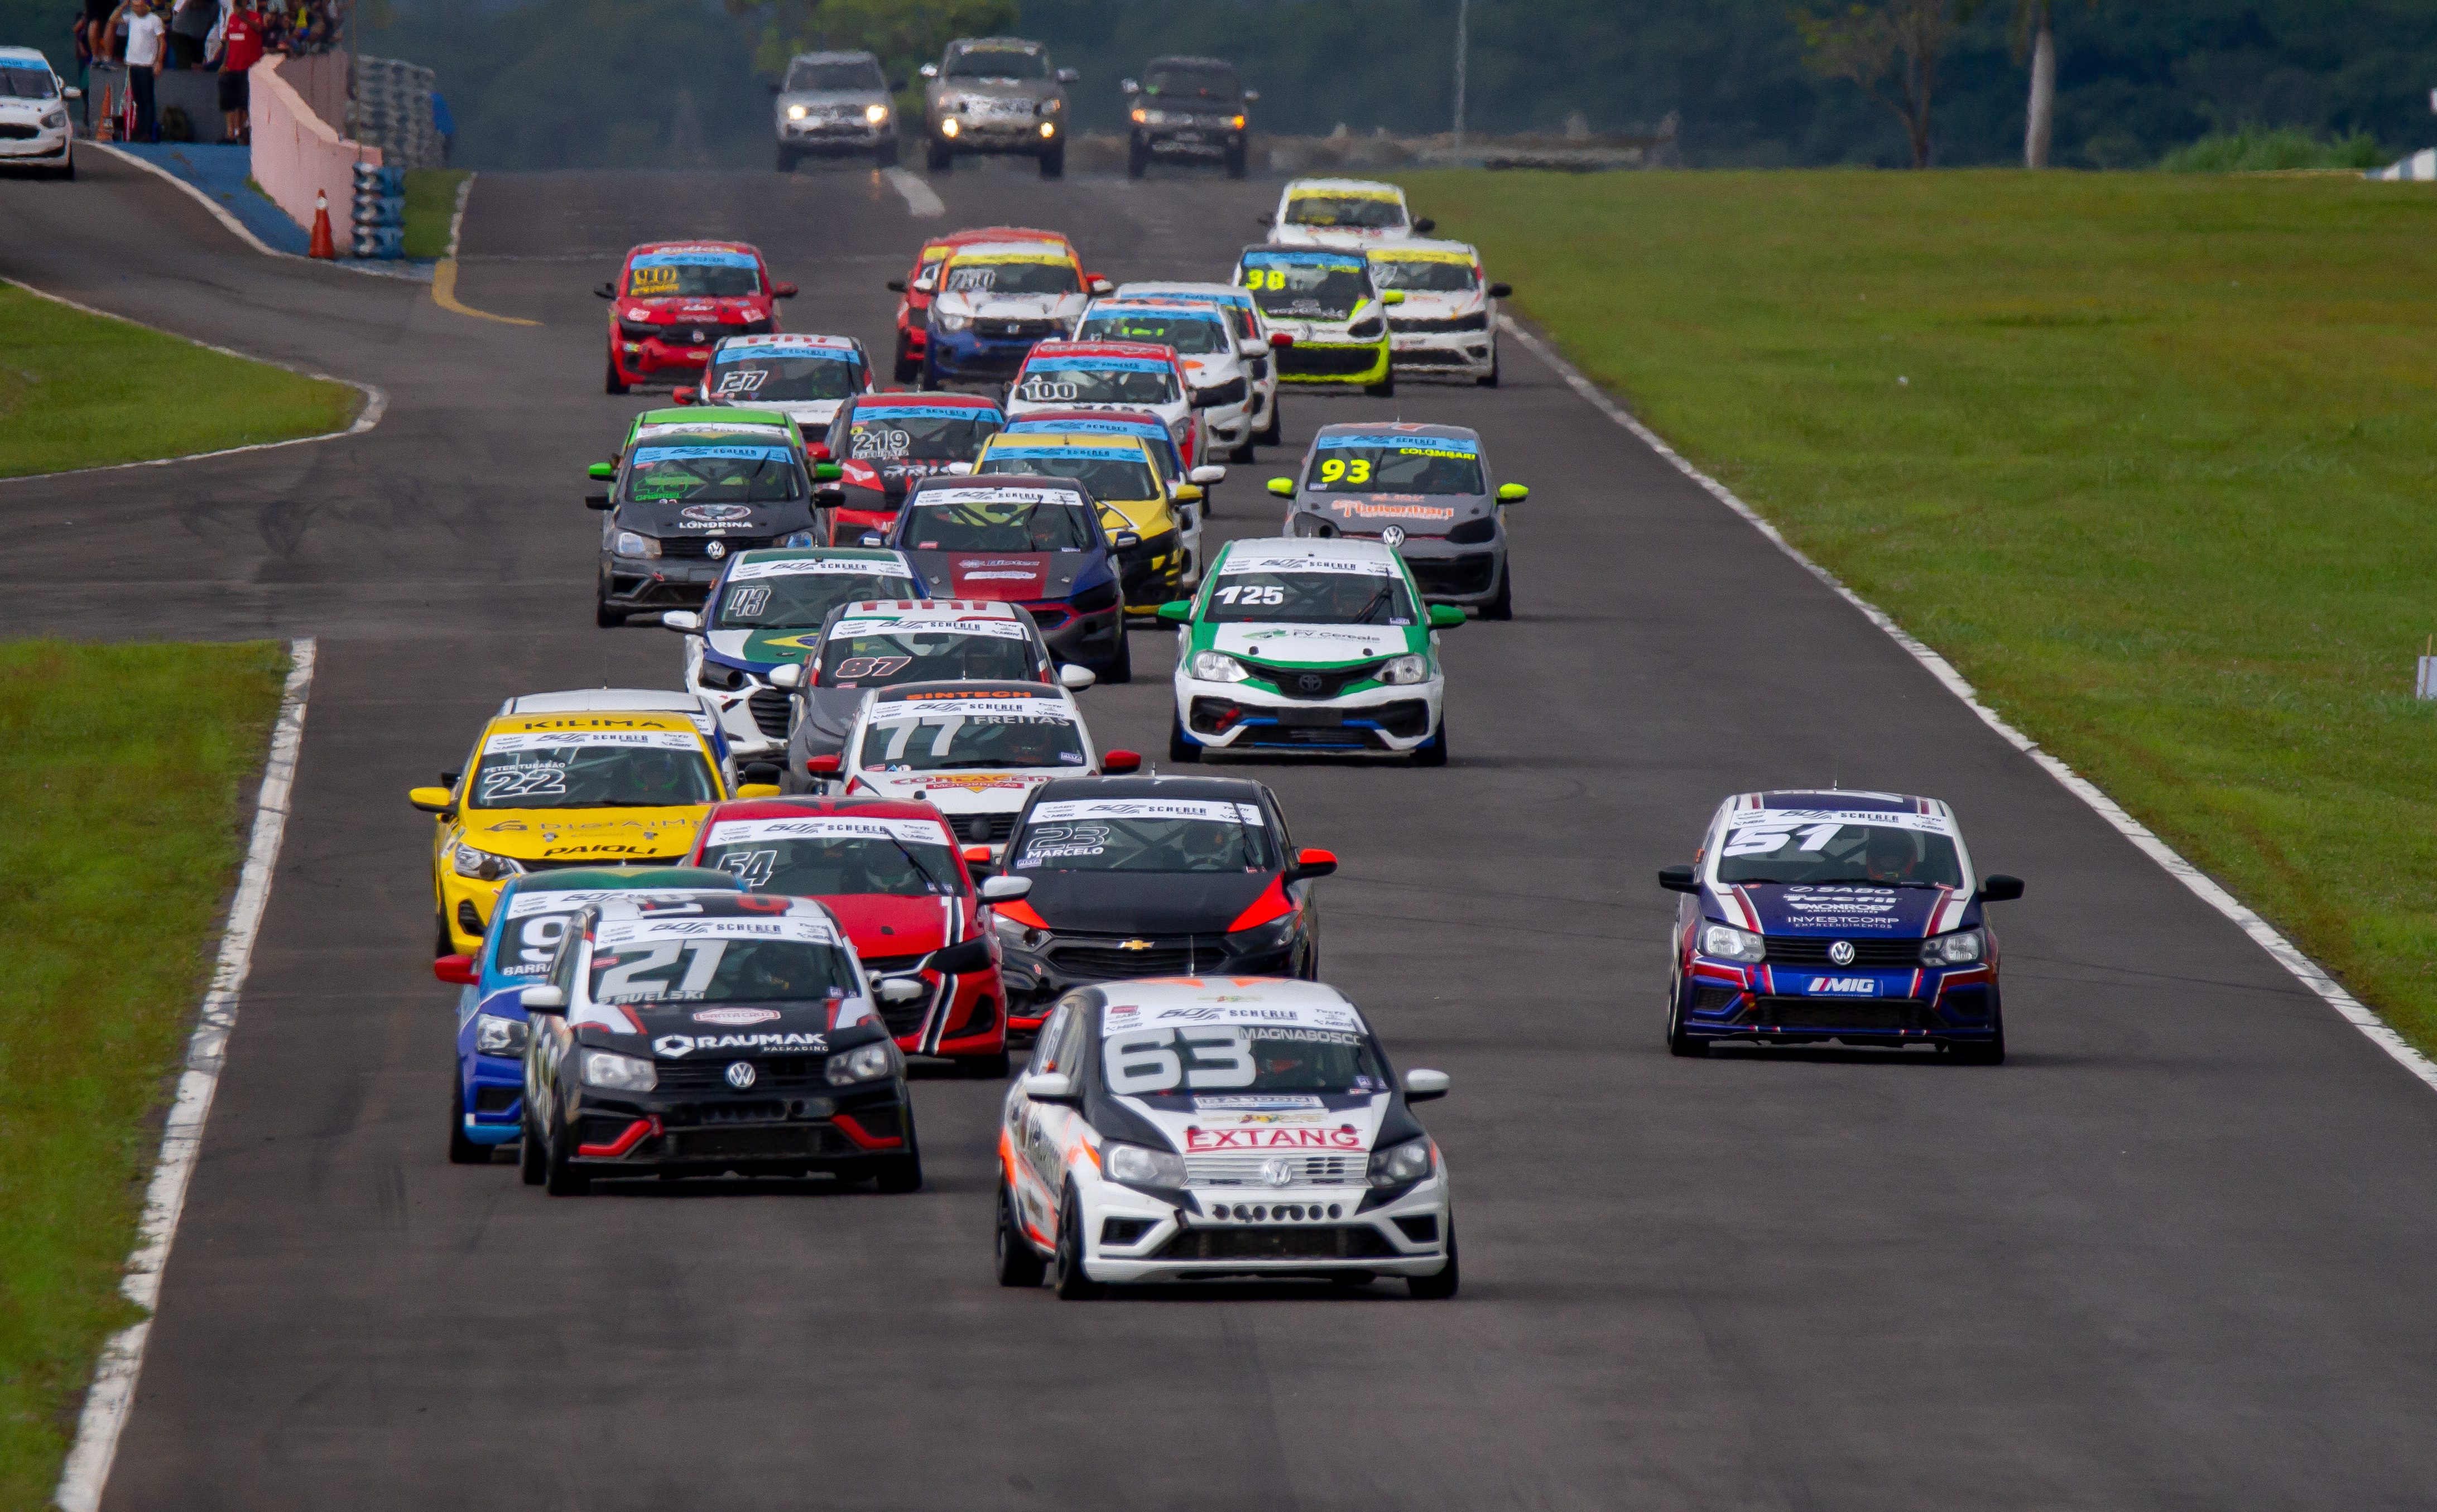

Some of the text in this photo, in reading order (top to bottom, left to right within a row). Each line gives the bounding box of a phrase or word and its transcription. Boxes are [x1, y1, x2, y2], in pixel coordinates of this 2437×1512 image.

[1246, 269, 1286, 291] 38
[1021, 381, 1078, 401] 100
[853, 430, 910, 457] 219
[1400, 447, 1476, 460] COLOMBARI
[1321, 458, 1372, 484] 93
[679, 520, 753, 529] LONDRINA
[1214, 585, 1285, 605] 125
[835, 656, 912, 678] 87
[525, 720, 666, 730] KILIMA
[974, 715, 1070, 726] FREITAS
[593, 734, 648, 743] SCHERER
[877, 715, 965, 760] 77
[484, 768, 566, 799] 22
[1148, 806, 1207, 814] SCHERER
[1840, 812, 1899, 821] SCHERER
[827, 824, 887, 832] SCHERER
[1026, 826, 1110, 851] 23
[1724, 824, 1844, 857] 51
[543, 844, 658, 857] PAIOLI
[1026, 847, 1104, 859] MARCELO
[717, 850, 778, 887] 54
[717, 923, 781, 933] SCHERER
[597, 940, 729, 1000] 21
[1229, 1009, 1297, 1019] SCHERER
[698, 1033, 828, 1048] RAUMAK
[1104, 1025, 1256, 1094] 63
[1186, 1128, 1361, 1148] EXTANG
